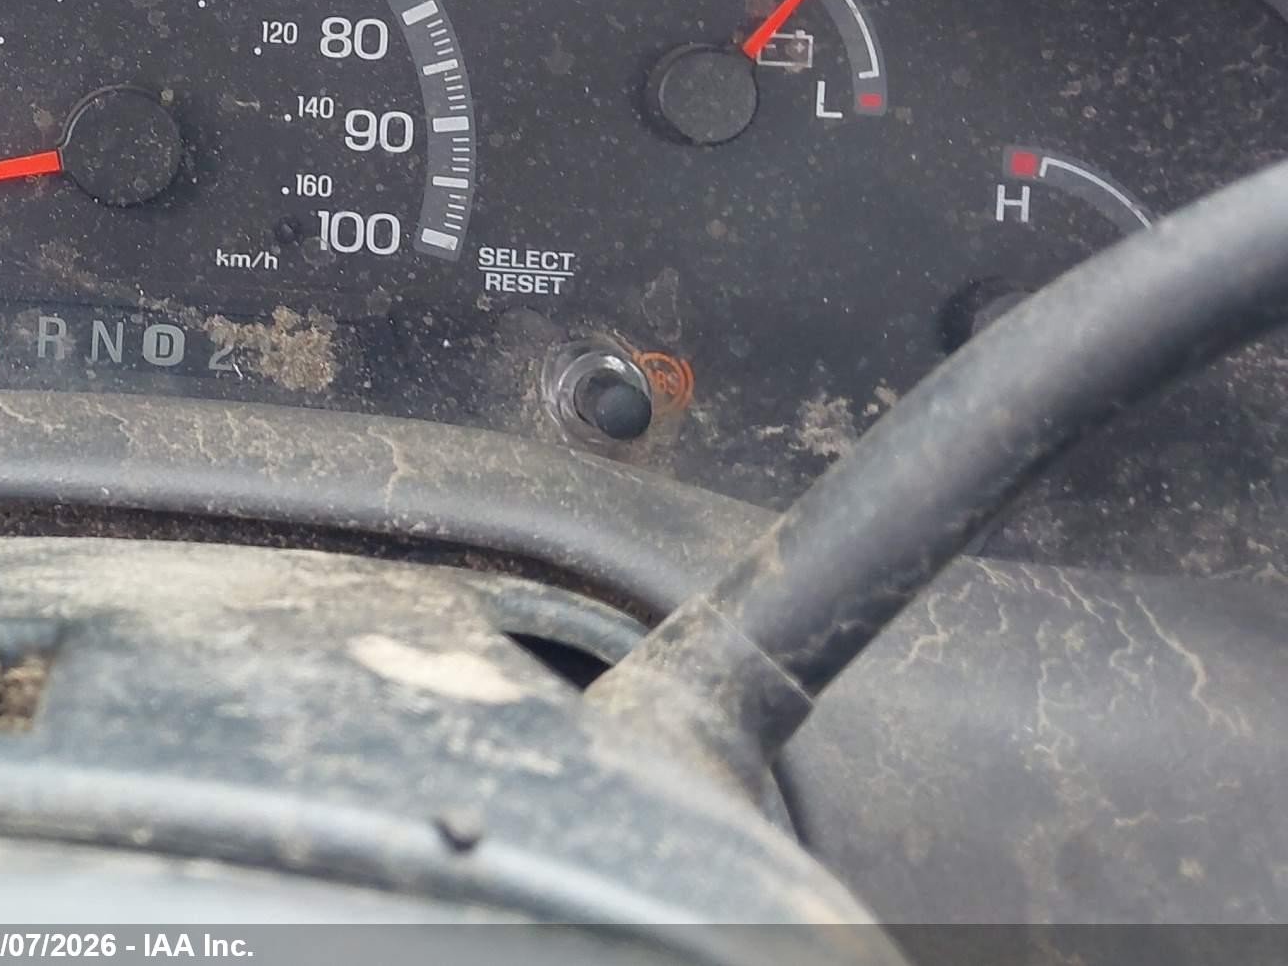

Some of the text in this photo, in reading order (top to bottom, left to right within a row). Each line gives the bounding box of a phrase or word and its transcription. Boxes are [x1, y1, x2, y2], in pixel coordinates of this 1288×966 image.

[261, 21, 299, 45] 120
[319, 17, 389, 60] 80
[296, 96, 334, 119] 140
[816, 81, 843, 119] L
[343, 110, 414, 153] 90
[295, 175, 333, 198] 160
[996, 184, 1030, 222] H
[318, 211, 401, 256] 100
[215, 248, 279, 272] km/h
[478, 246, 574, 271] SELECT
[484, 273, 565, 296] RESET
[37, 316, 67, 360] R
[91, 320, 124, 363] N
